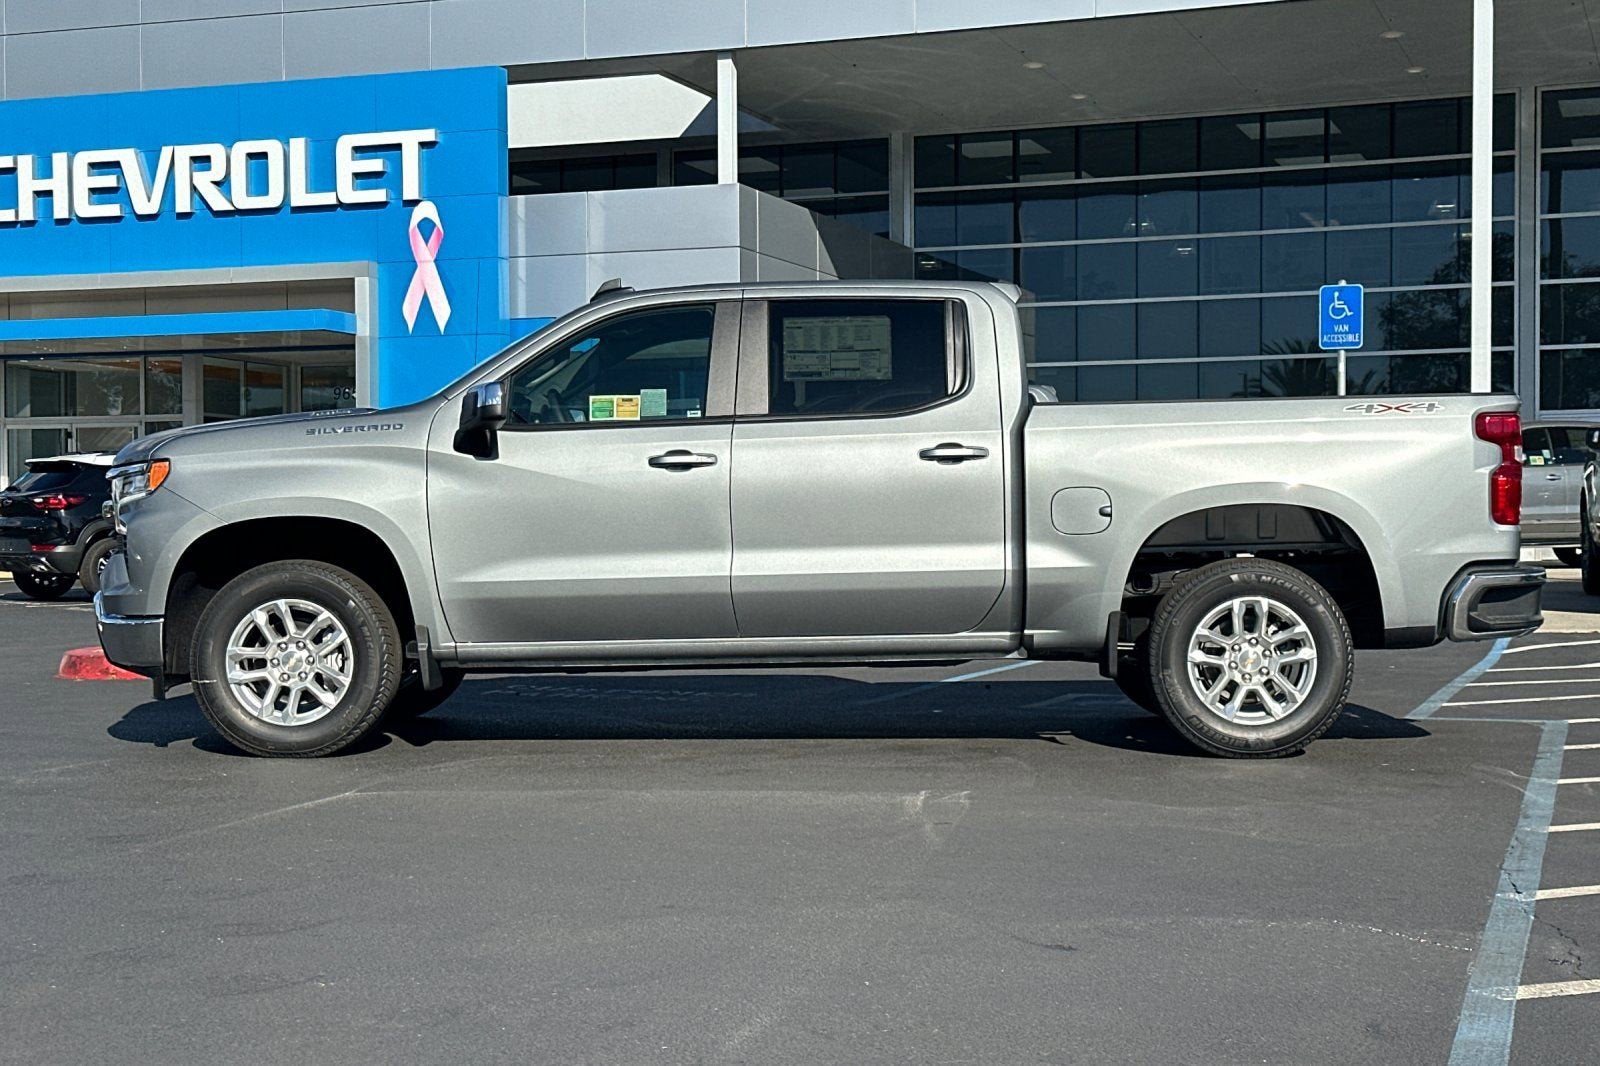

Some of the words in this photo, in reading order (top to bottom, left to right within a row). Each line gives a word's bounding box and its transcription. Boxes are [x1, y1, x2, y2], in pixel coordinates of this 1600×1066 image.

[1333, 324, 1349, 333] VAN
[1323, 333, 1360, 343] ACCESSIBLE
[306, 423, 403, 435] SILVERADO
